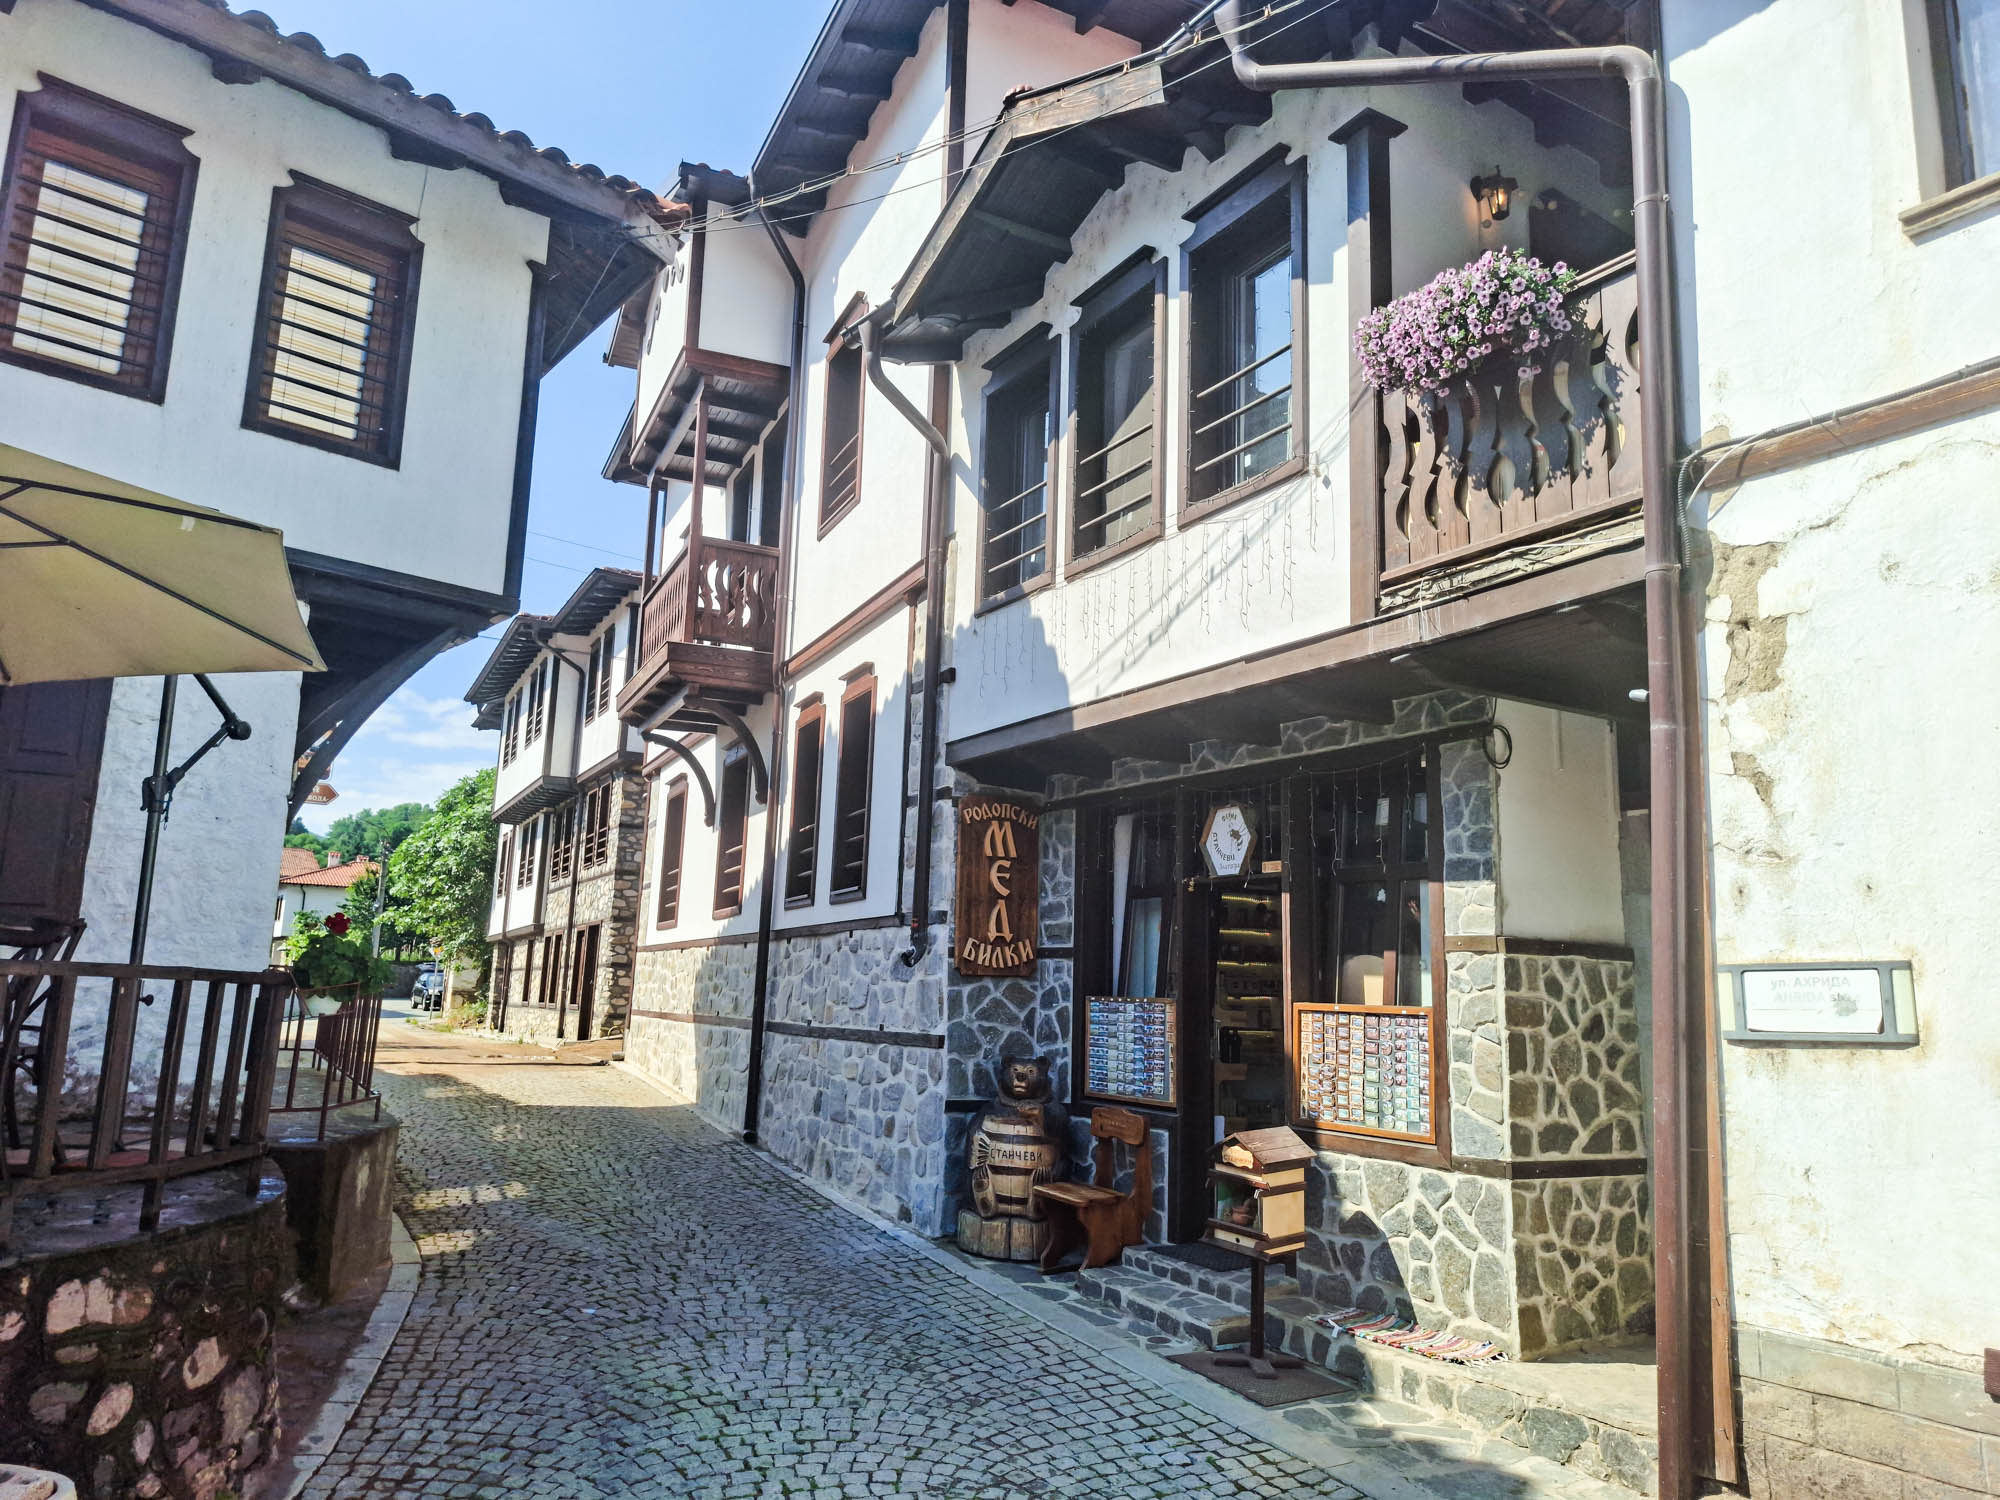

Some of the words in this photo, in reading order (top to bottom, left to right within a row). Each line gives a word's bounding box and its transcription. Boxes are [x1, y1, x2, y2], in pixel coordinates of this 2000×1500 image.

[963, 803, 1039, 829] РОДОПСКИ
[984, 820, 1017, 943] МЕД
[962, 937, 1034, 968] БИЛКИ
[1793, 976, 1851, 990] АХРИДА
[990, 1148, 1043, 1161] СТАНЧЕВИ
